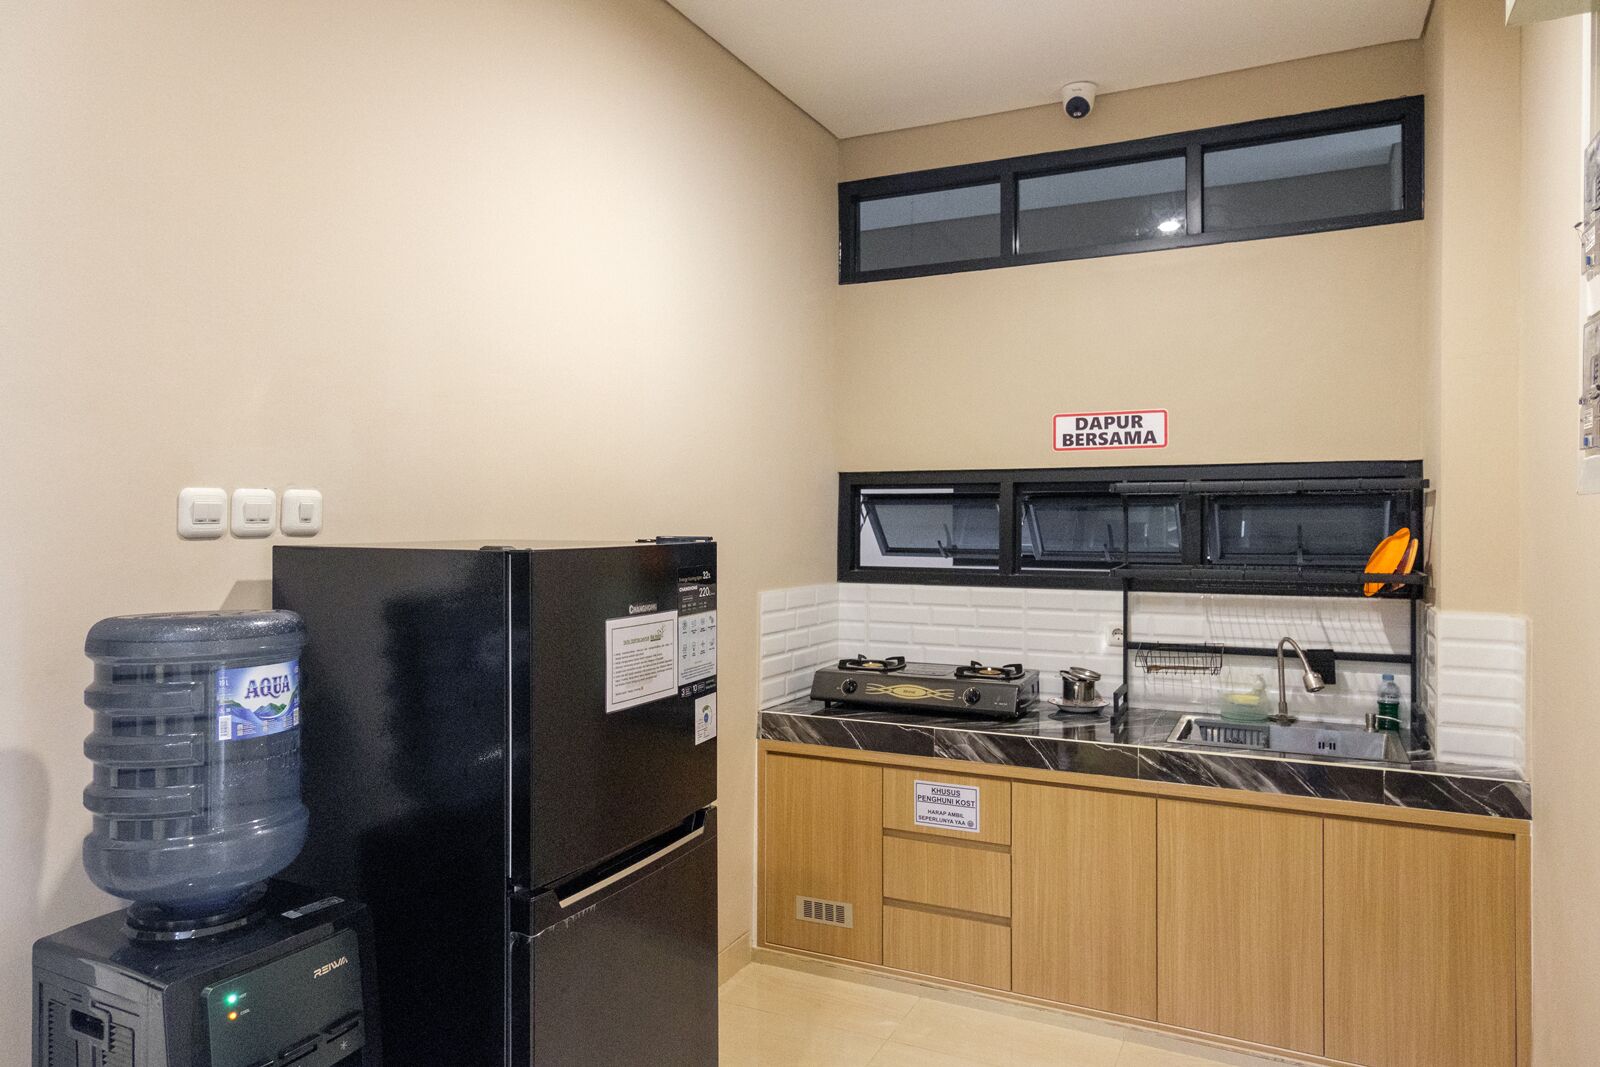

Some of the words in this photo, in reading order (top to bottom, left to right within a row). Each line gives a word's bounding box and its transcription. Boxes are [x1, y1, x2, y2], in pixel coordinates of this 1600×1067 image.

[1075, 415, 1143, 431] DAPUR
[1062, 430, 1157, 447] BERSAMA
[244, 674, 291, 699] AQUA
[931, 787, 961, 797] KHUSUS
[917, 794, 954, 806] PENGHUNI
[955, 799, 976, 808] KOST
[918, 815, 954, 824] SEPERLUNYA
[313, 956, 349, 979] REIWA
